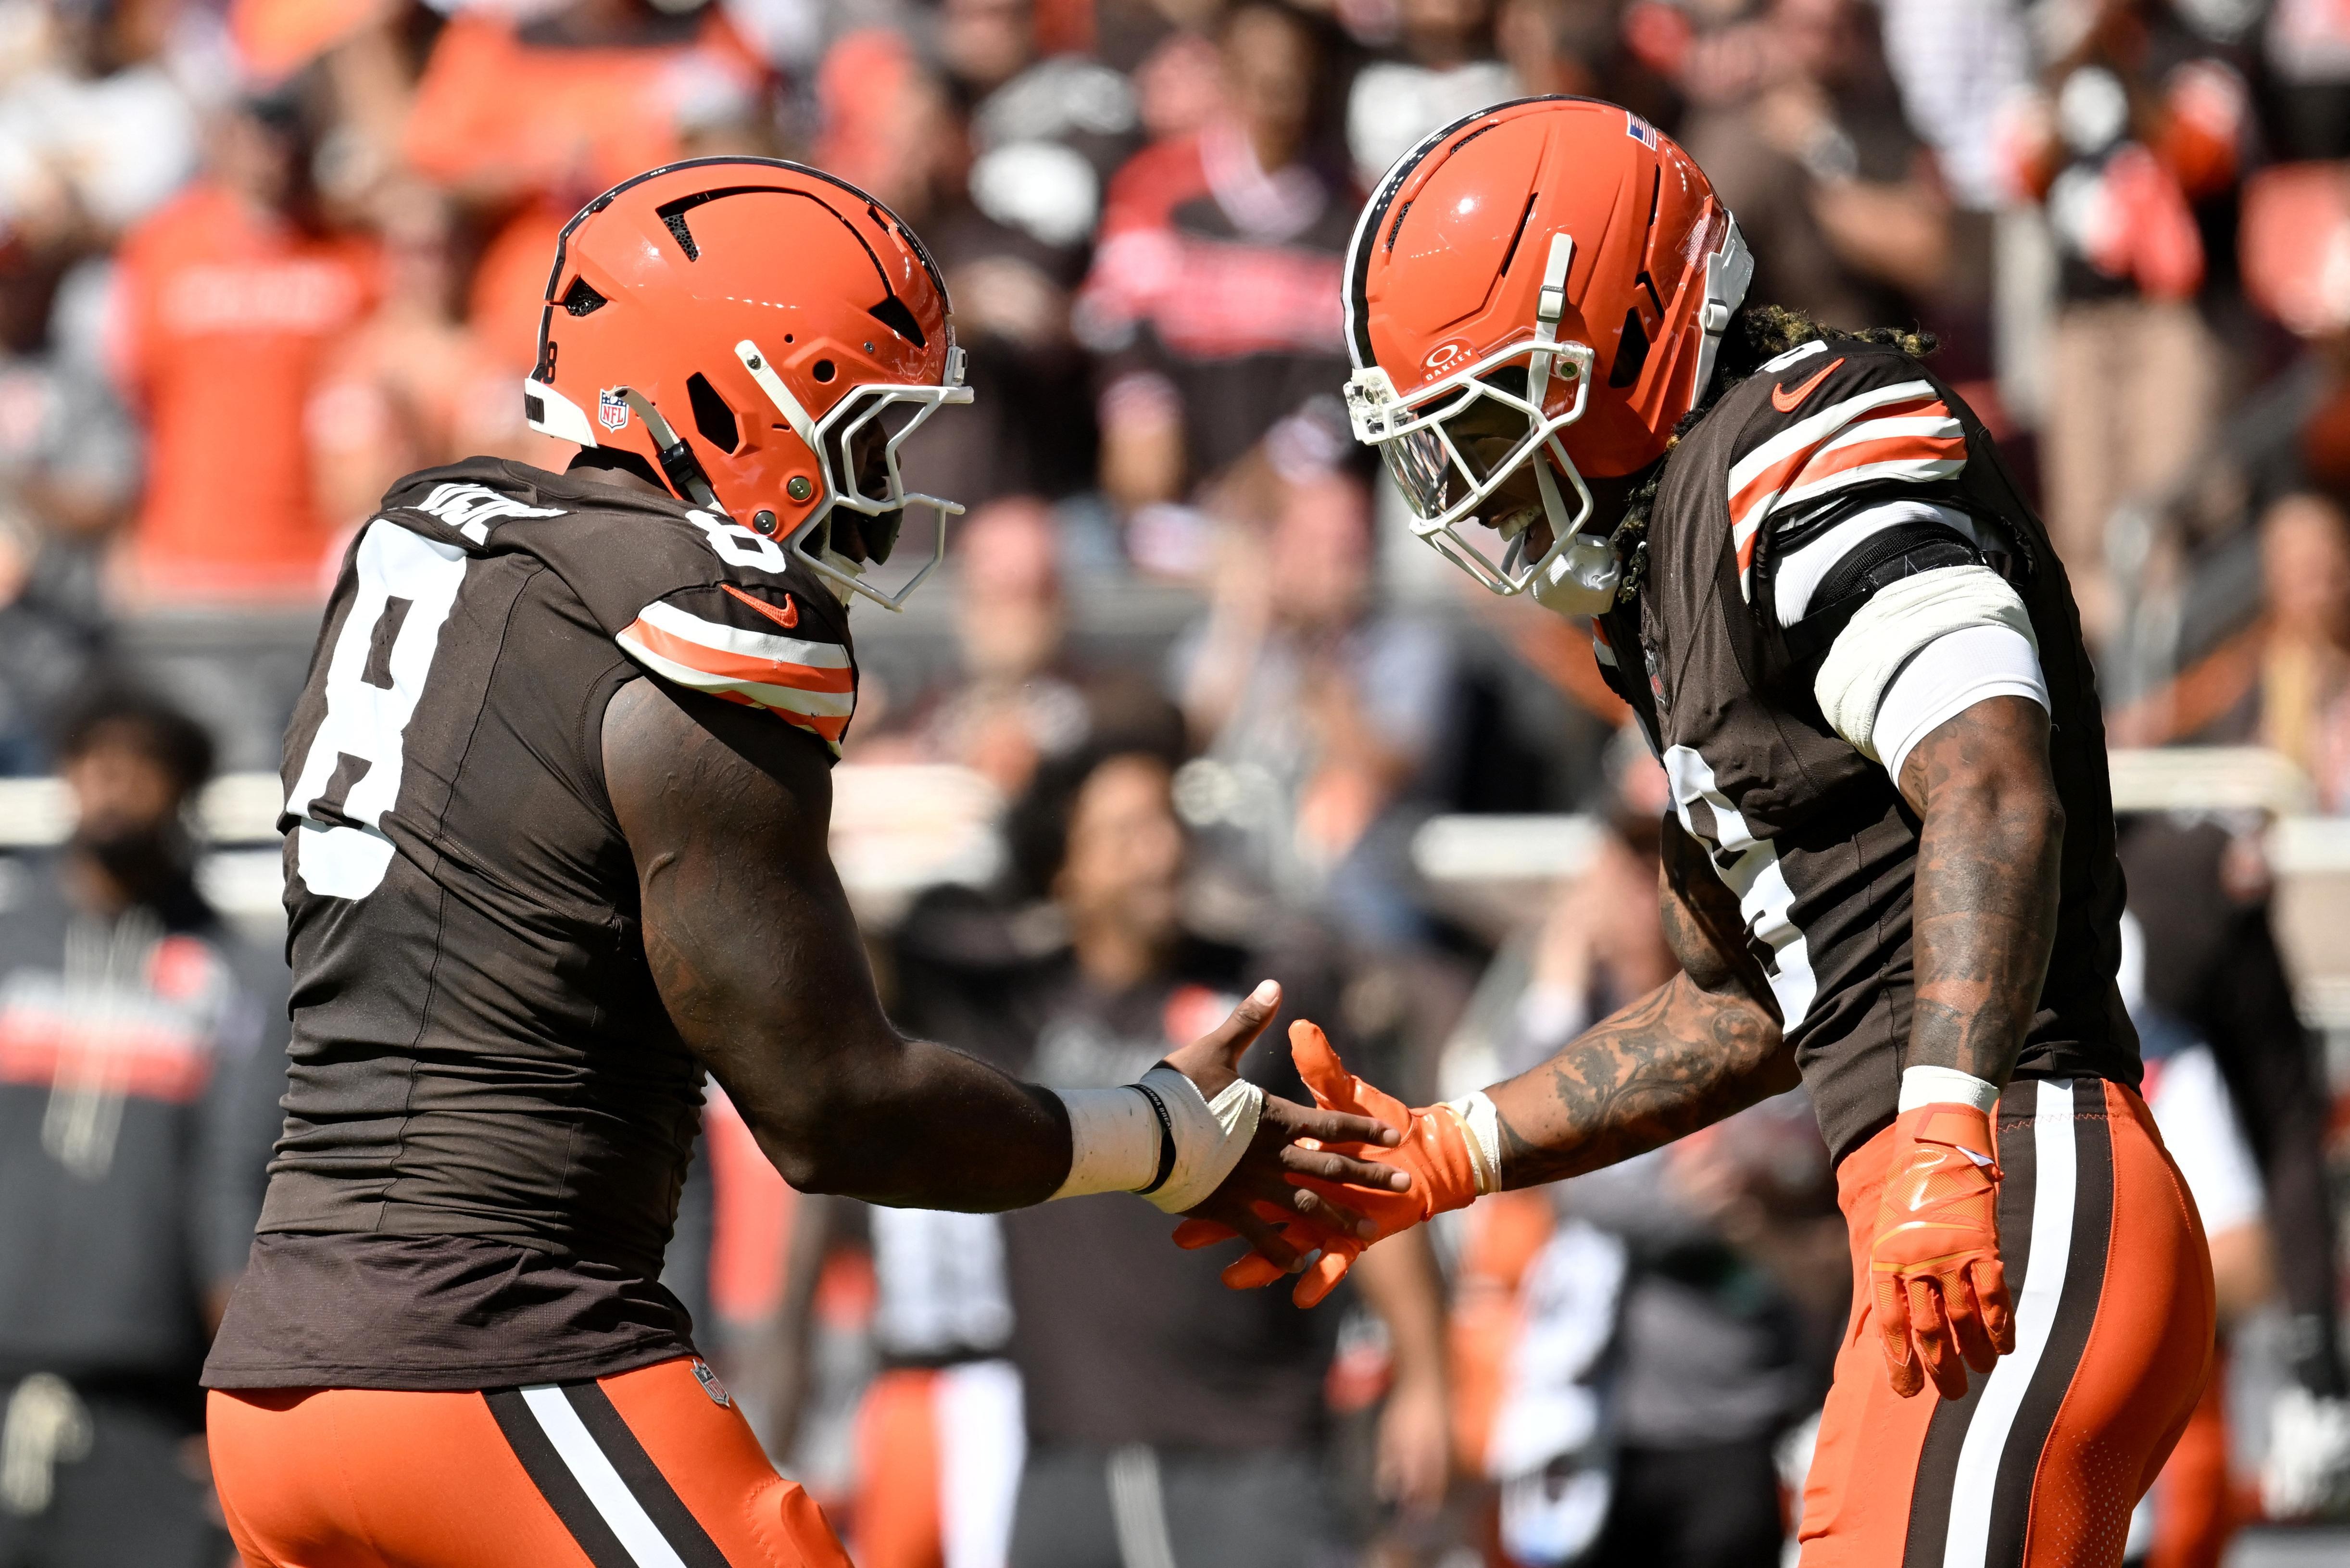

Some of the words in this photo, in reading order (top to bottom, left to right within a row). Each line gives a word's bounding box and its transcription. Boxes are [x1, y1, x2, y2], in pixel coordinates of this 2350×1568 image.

[543, 340, 558, 385] 8
[1425, 347, 1473, 381] OAKLEY
[603, 405, 624, 424] NFL
[287, 518, 467, 901] 8
